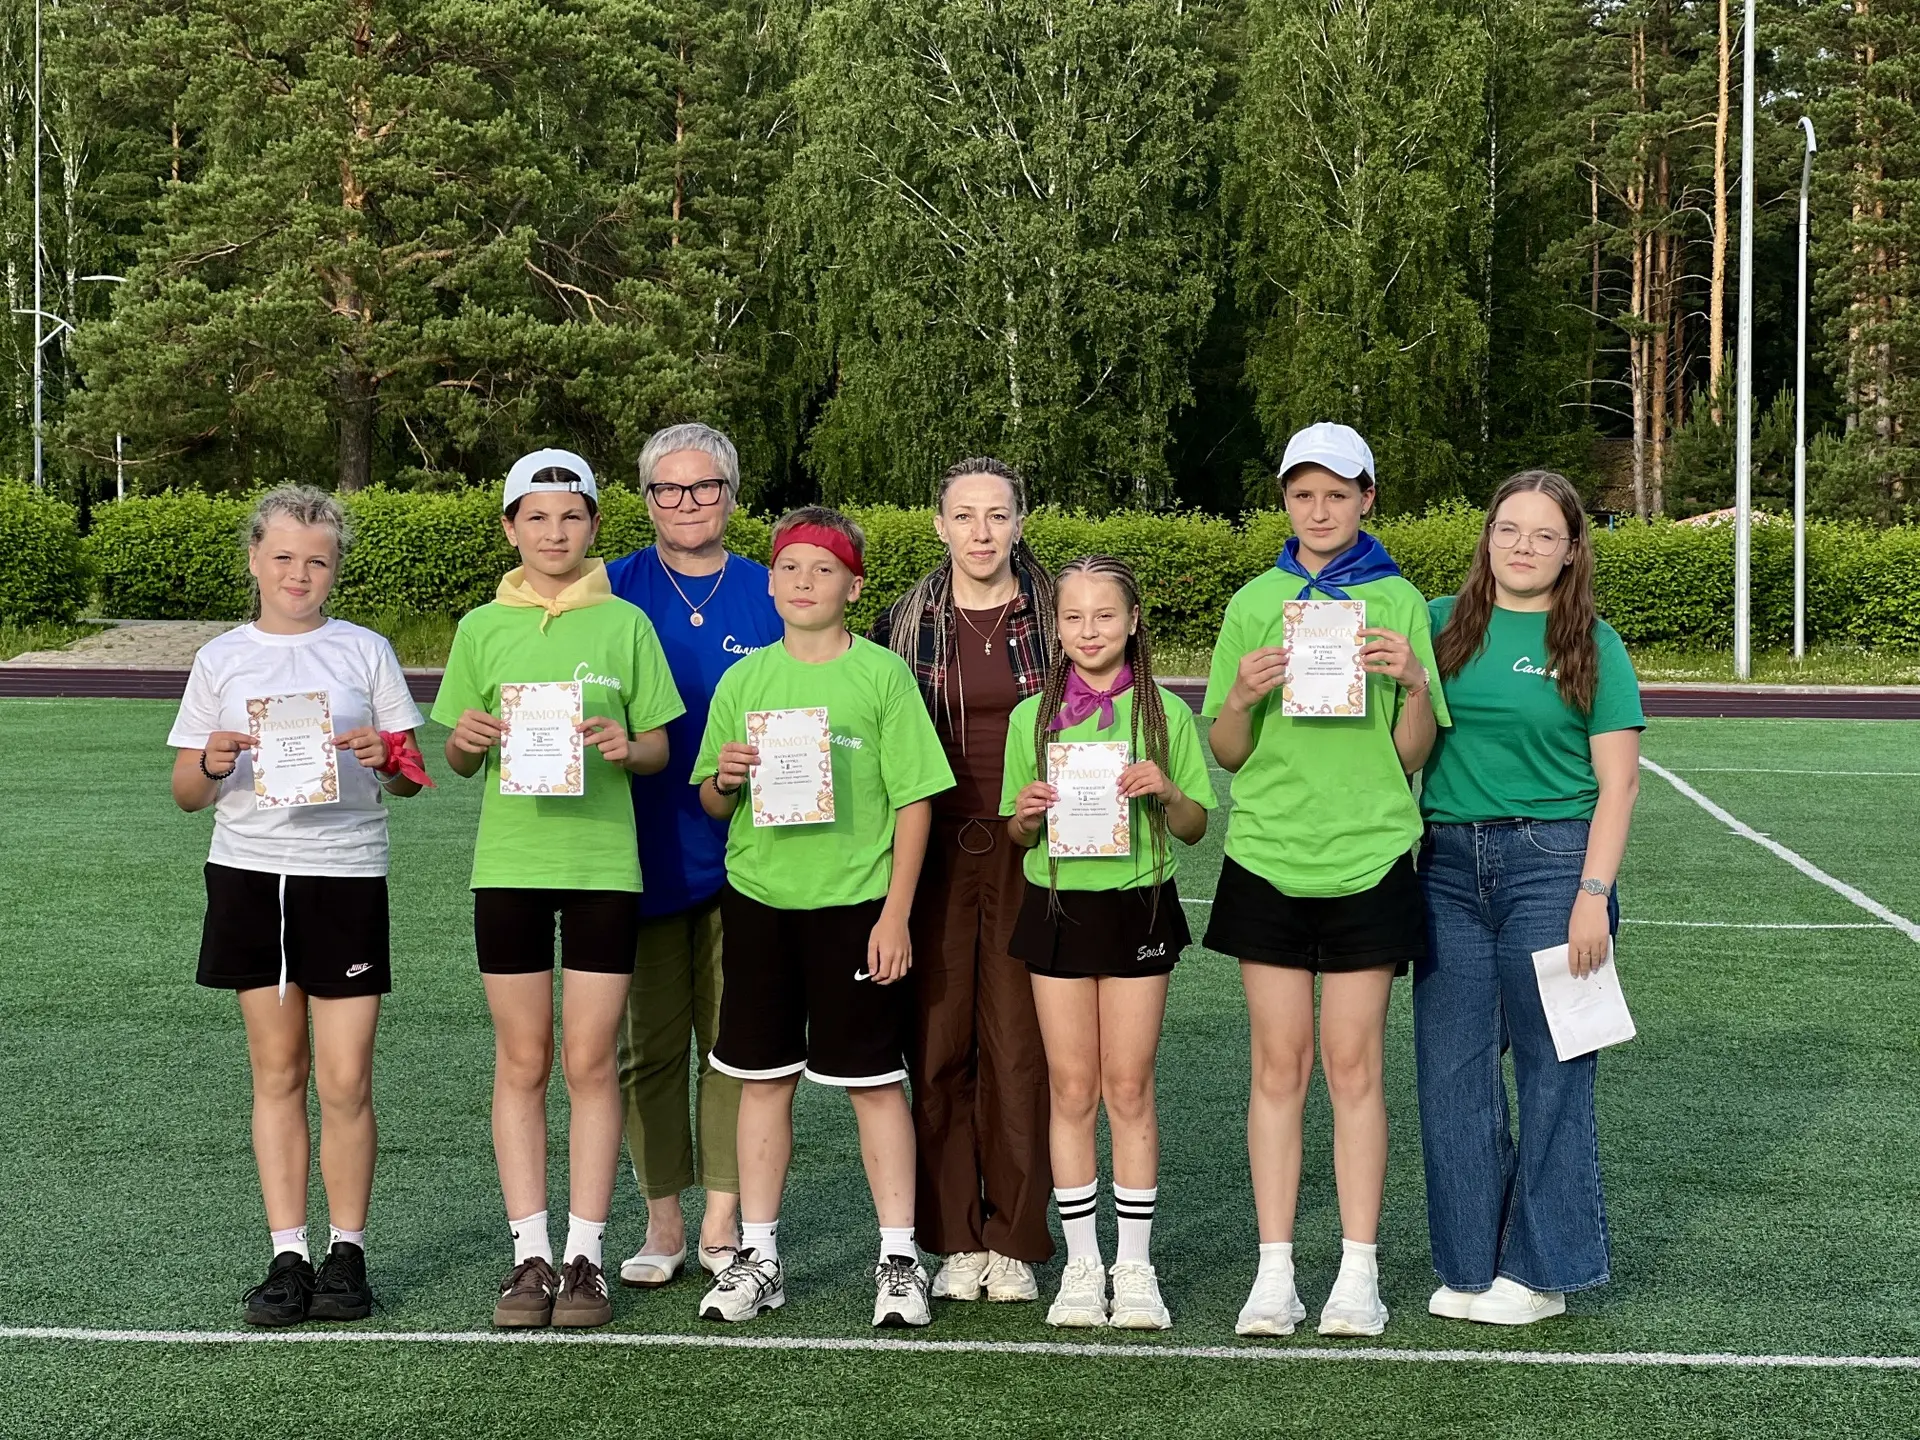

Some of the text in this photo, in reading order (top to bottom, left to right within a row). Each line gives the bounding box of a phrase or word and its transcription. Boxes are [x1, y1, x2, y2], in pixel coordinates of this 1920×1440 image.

[1297, 627, 1353, 637] ГРАМОТА
[573, 661, 622, 690] Салют
[514, 709, 570, 720] ГРАМОТА
[263, 717, 320, 731] ГРАМОТА
[761, 735, 817, 748] ГРАМОТА
[1061, 769, 1116, 779] ГРАМОТА
[1136, 942, 1166, 961] Soul
[350, 962, 369, 971] NIKE
